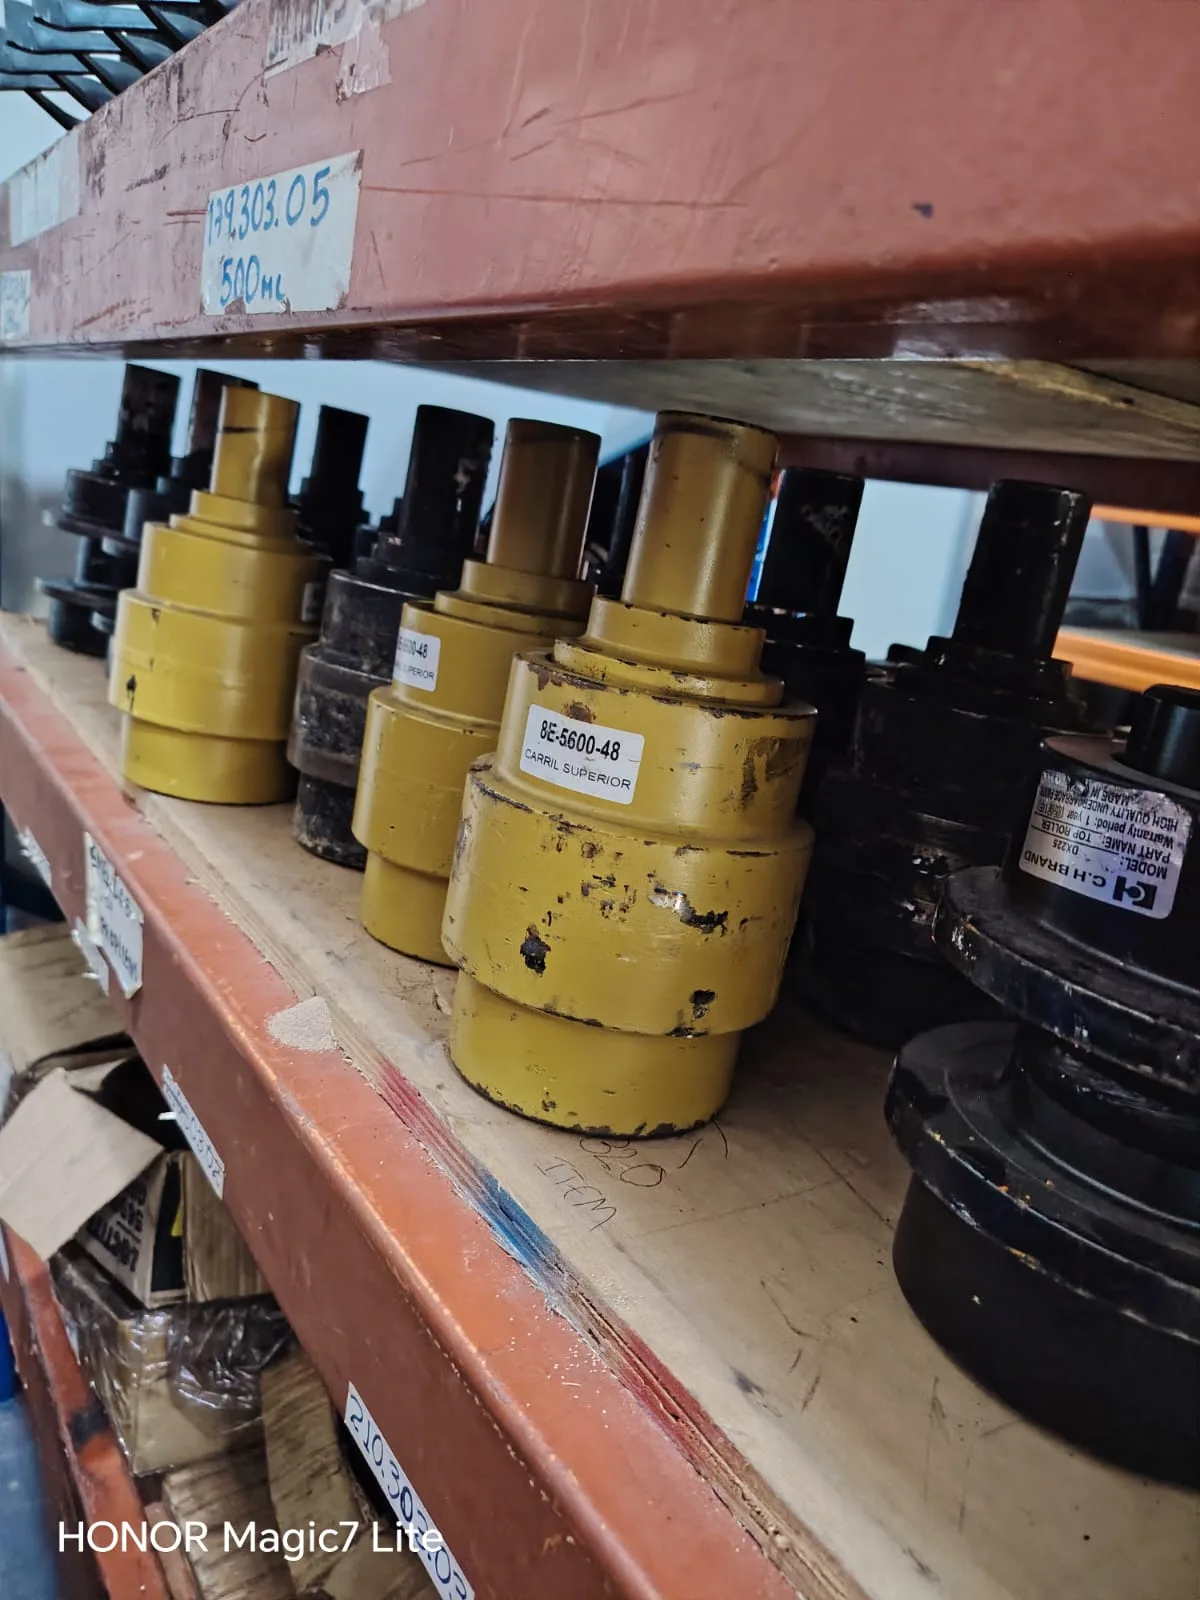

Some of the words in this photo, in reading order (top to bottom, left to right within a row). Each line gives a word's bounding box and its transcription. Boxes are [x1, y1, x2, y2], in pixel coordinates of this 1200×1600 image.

[540, 720, 621, 761] 8E-5600-48
[525, 749, 559, 770] CARRIL
[562, 763, 631, 790] SUPERIOR
[1093, 816, 1126, 834] period:
[1110, 804, 1150, 825] QUALITY
[1152, 811, 1179, 832] HIGH
[1041, 820, 1071, 839] ROLLER
[1072, 831, 1091, 843] TOP
[1128, 826, 1174, 849] Warranty
[1052, 839, 1079, 855] DX225
[1102, 836, 1137, 855] NAME:
[1139, 846, 1171, 864] PART
[1024, 851, 1070, 876] BRAND
[1120, 856, 1168, 880] MODEL:
[1073, 868, 1107, 888] C.H
[534, 1156, 618, 1232] ITEM
